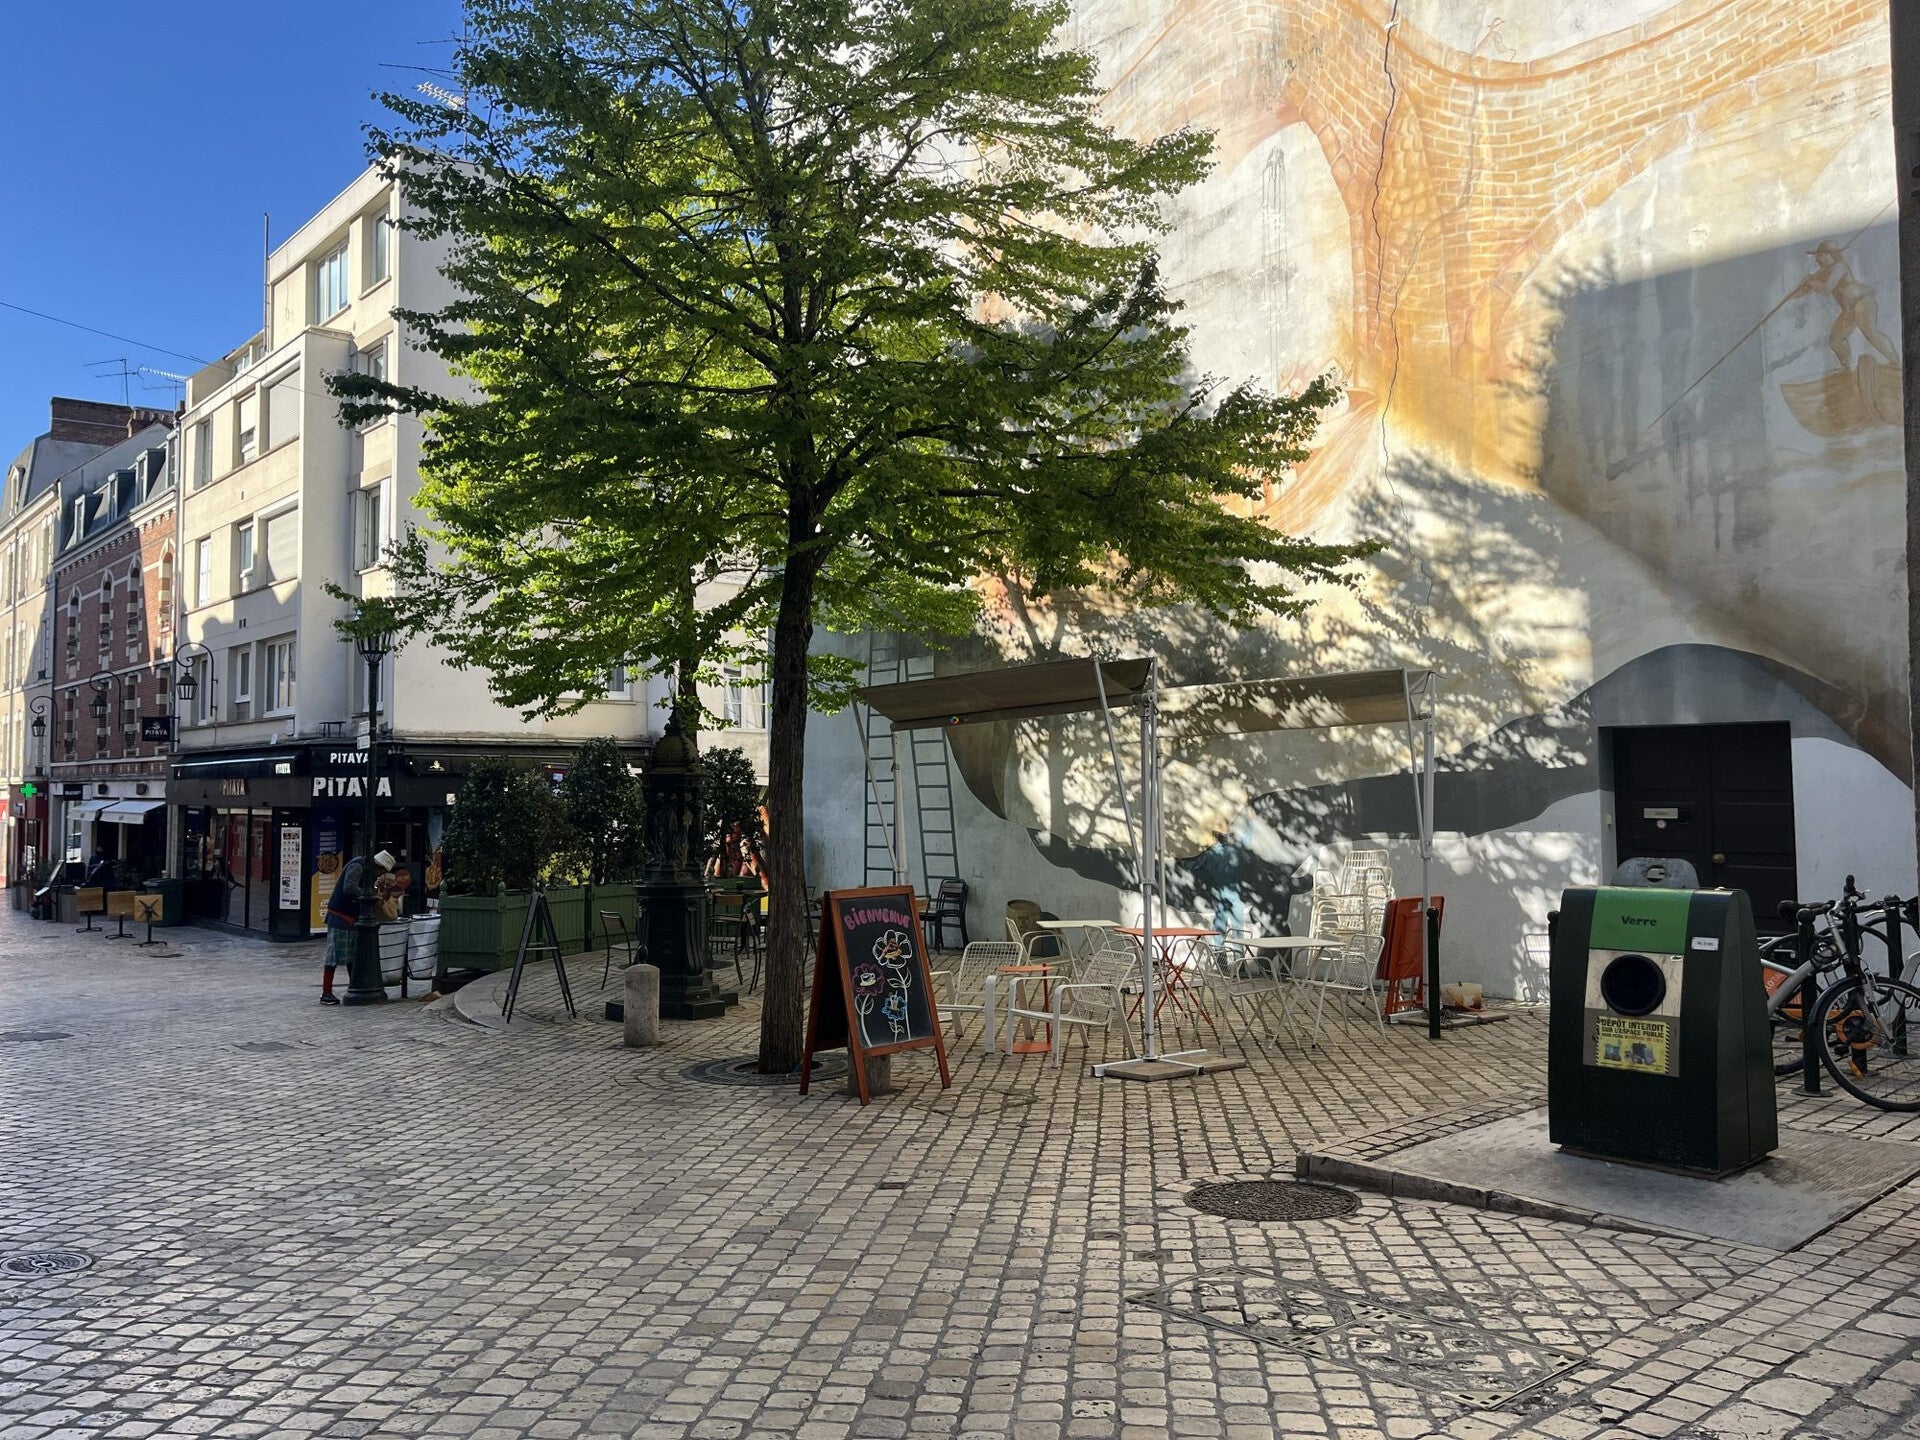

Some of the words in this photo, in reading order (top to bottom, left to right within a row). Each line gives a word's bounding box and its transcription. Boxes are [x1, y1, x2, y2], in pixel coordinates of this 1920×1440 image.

[1621, 915, 1657, 926] Verre
[1628, 1021, 1665, 1032] INTERDIT
[1643, 1030, 1664, 1038] PUBLIC
